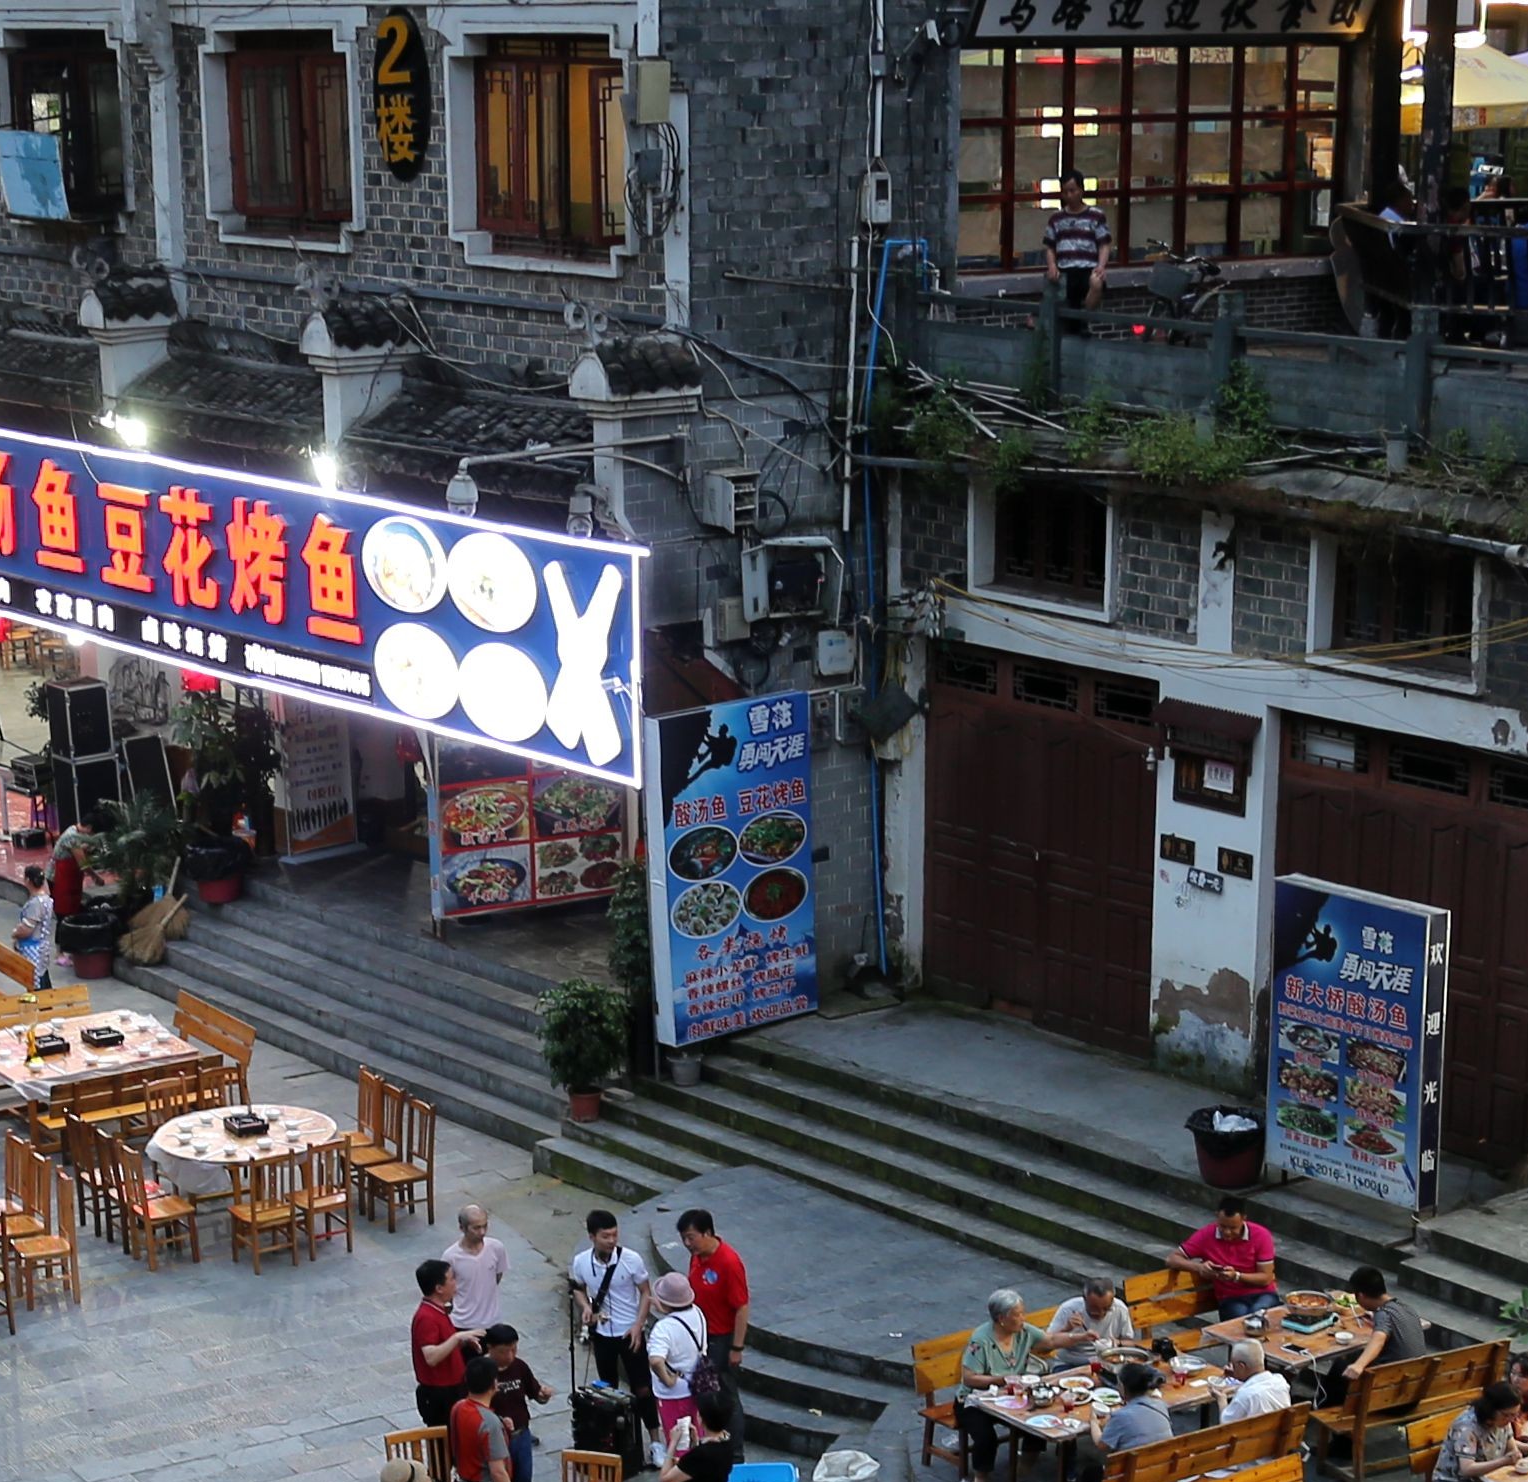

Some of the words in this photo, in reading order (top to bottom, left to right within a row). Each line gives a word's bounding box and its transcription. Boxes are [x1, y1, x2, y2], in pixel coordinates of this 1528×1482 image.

[375, 15, 416, 165] 2楼
[748, 699, 793, 735] 雪花
[737, 732, 806, 773] 勇闯天涯
[674, 795, 728, 830] 酸汤鱼
[738, 777, 808, 817] 豆花烤鱼
[1361, 925, 1394, 955] 雪花
[684, 955, 760, 987] 麻辣小龙虾
[1339, 951, 1414, 995] 勇闯天涯
[750, 995, 809, 1025] 欢迎品尝
[1284, 974, 1409, 1031] 新大桥酸汤鱼
[1420, 942, 1444, 1174] 欢迎光临
